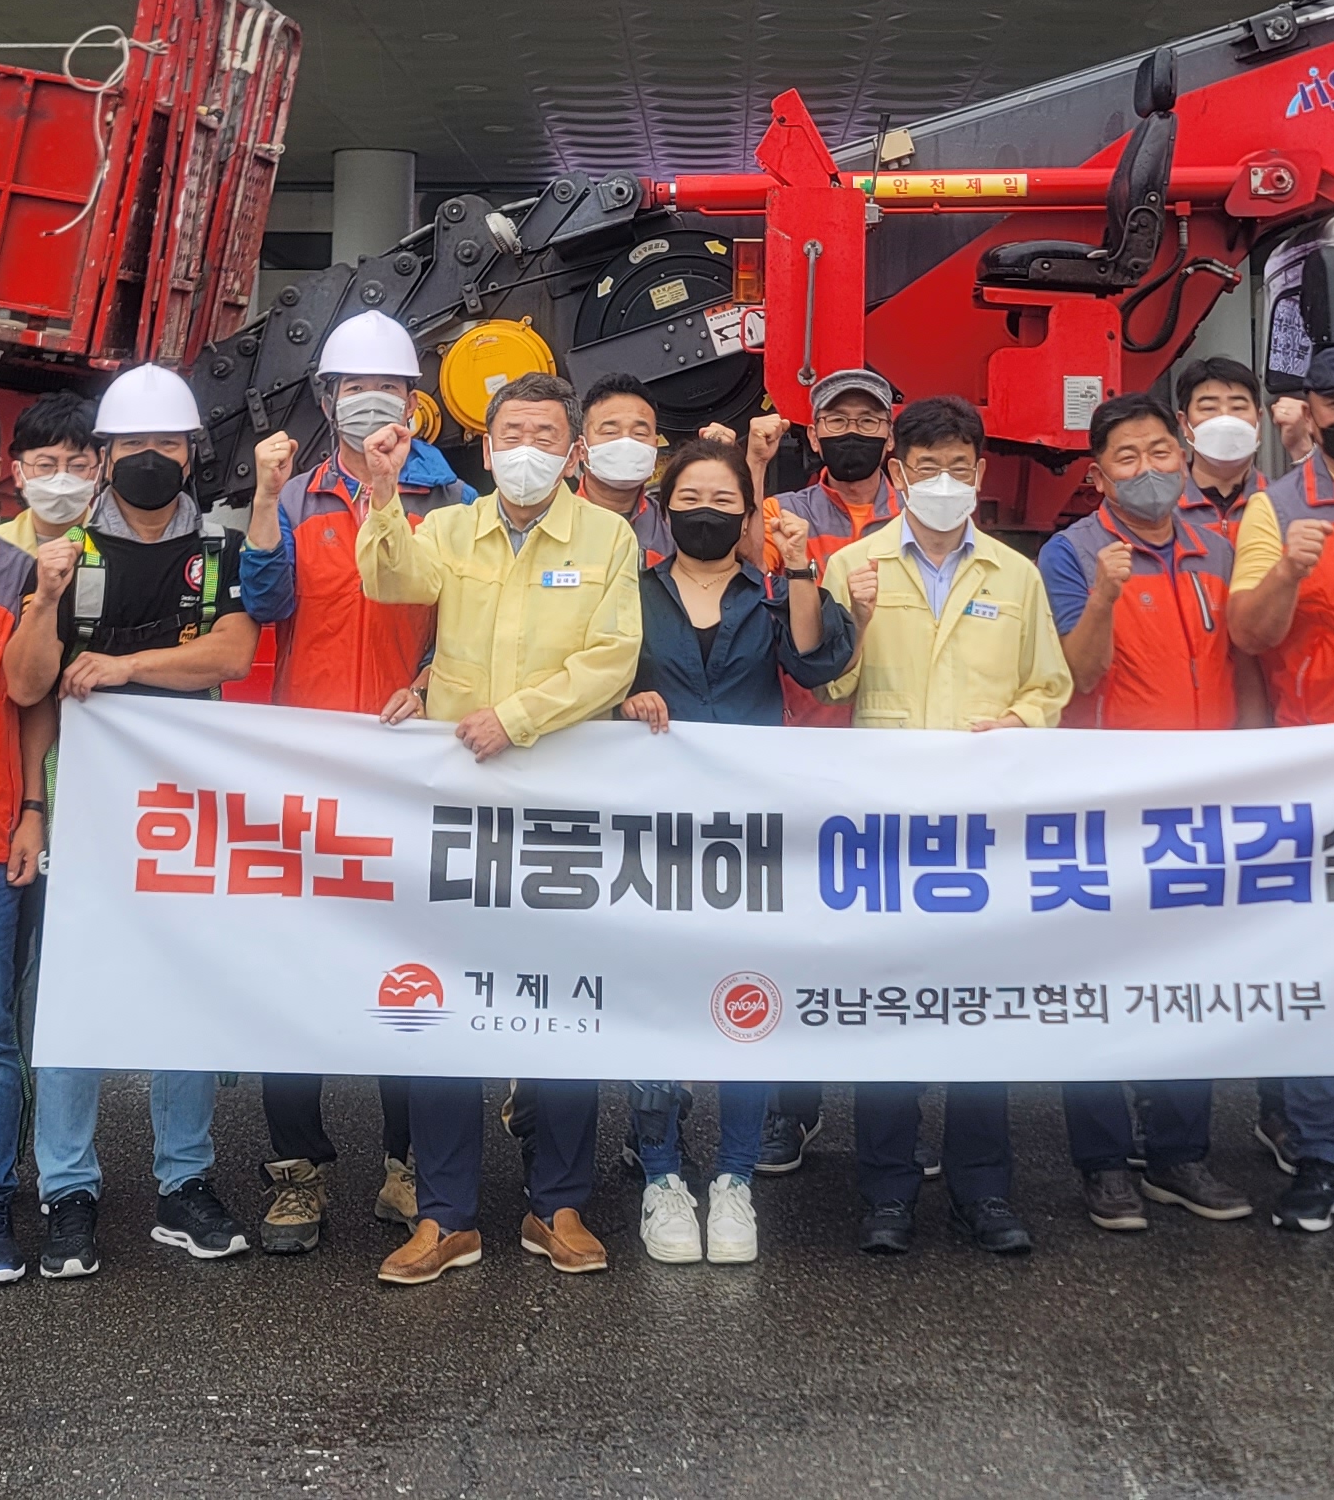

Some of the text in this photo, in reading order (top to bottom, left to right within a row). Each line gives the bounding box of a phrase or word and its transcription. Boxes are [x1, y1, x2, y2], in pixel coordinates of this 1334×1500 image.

[135, 782, 395, 902] 힌남노
[429, 804, 784, 913] 태풍재해
[817, 812, 996, 914] 예방
[1024, 810, 1112, 913] 및
[464, 971, 603, 1011] 거제시
[795, 982, 1328, 1027] 경남옥외광고협회 거제시지부
[470, 1014, 601, 1036] GEOJE-SI
